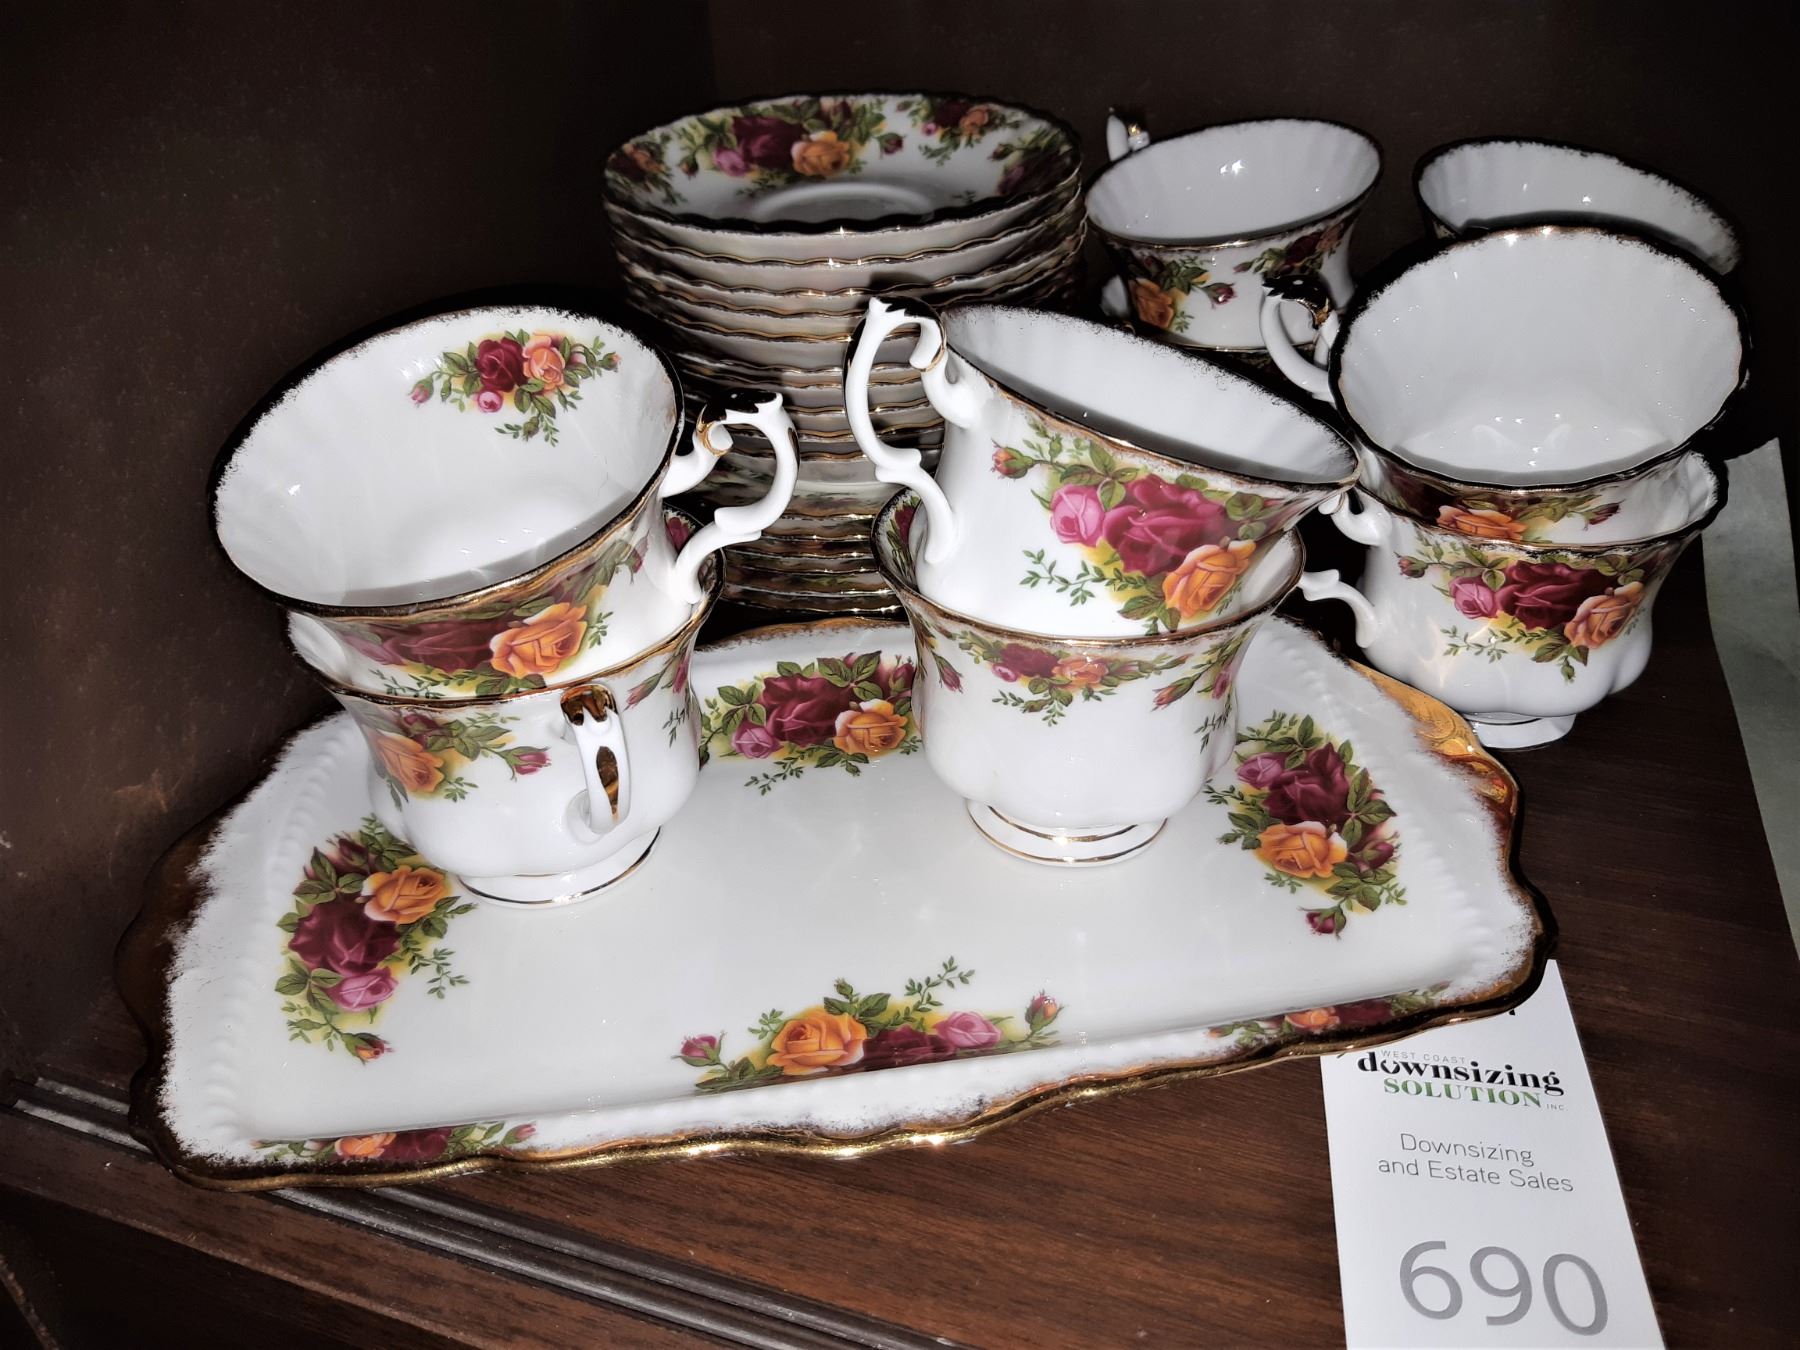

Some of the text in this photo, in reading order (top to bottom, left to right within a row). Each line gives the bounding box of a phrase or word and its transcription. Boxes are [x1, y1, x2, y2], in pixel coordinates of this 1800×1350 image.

[1381, 1050, 1466, 1064] WEST COAST
[1357, 1051, 1565, 1097] downsizing
[1383, 1078, 1542, 1108] SOLUTION
[1400, 1133, 1535, 1167] Downsizing
[1378, 1159, 1574, 1192] and Estate Sales
[1400, 1240, 1608, 1336] 690
